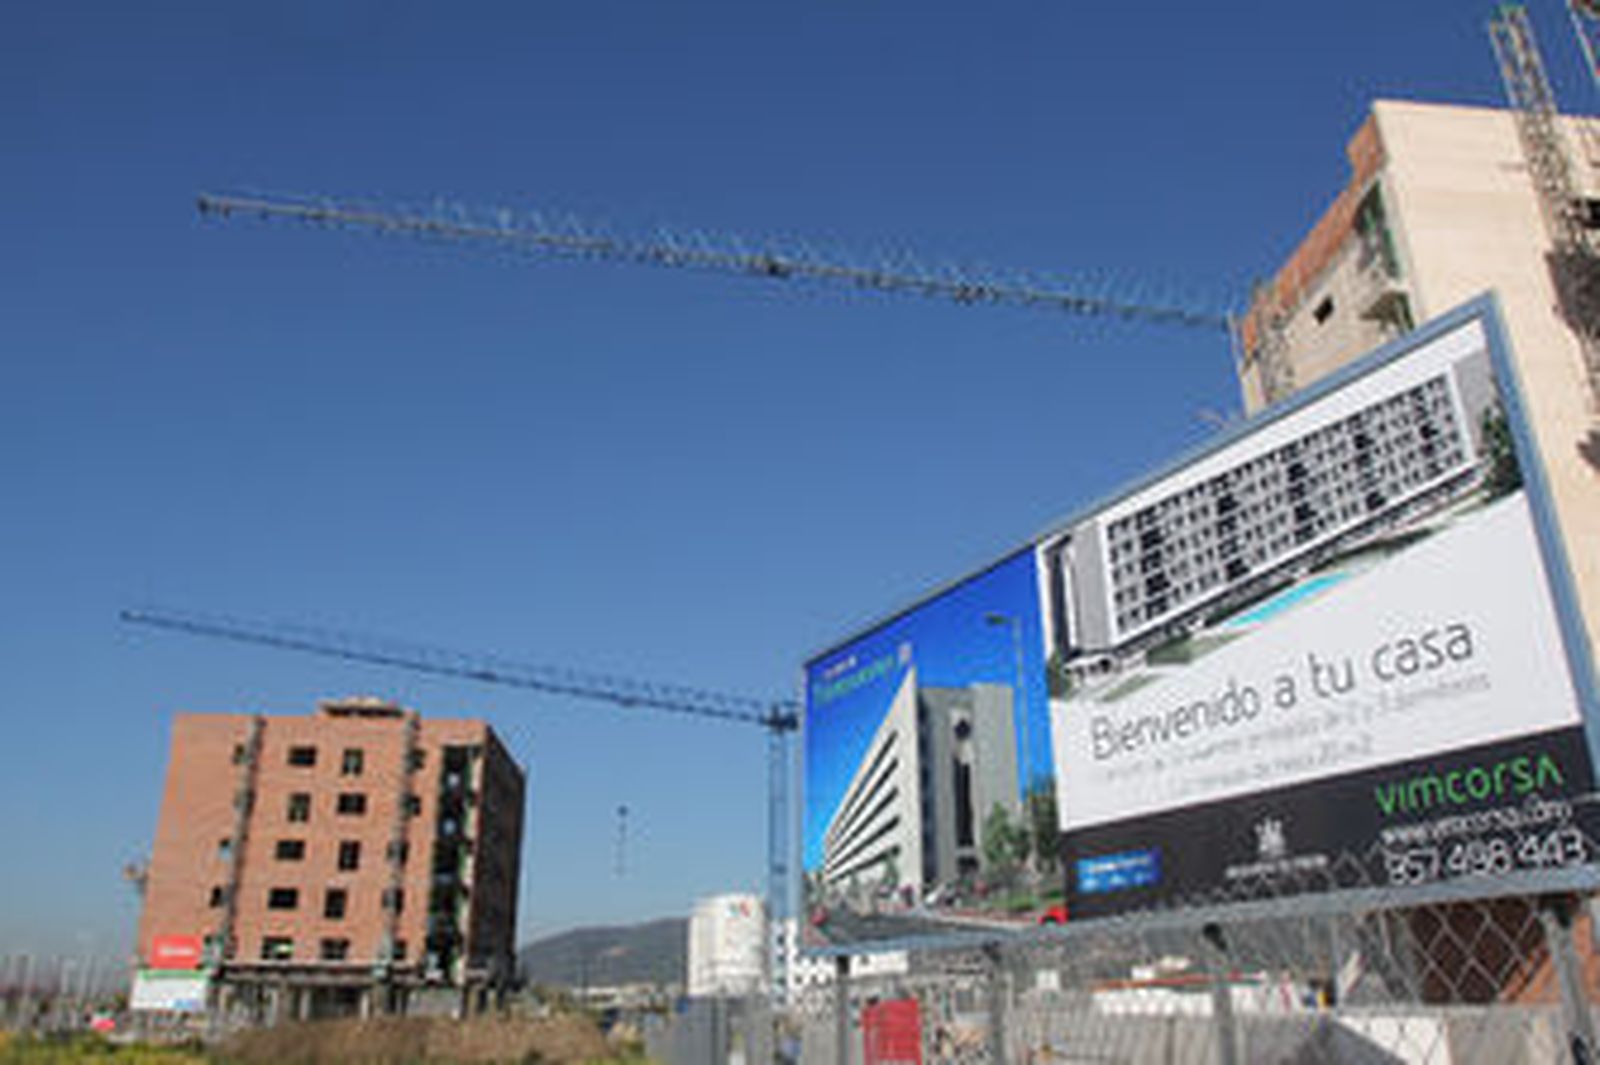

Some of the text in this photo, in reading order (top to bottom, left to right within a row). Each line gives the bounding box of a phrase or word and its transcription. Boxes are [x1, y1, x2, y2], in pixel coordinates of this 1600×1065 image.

[1091, 677, 1261, 760] Bienvenido
[1274, 673, 1297, 709] a
[1307, 652, 1355, 697] tu
[1371, 623, 1475, 681] casa
